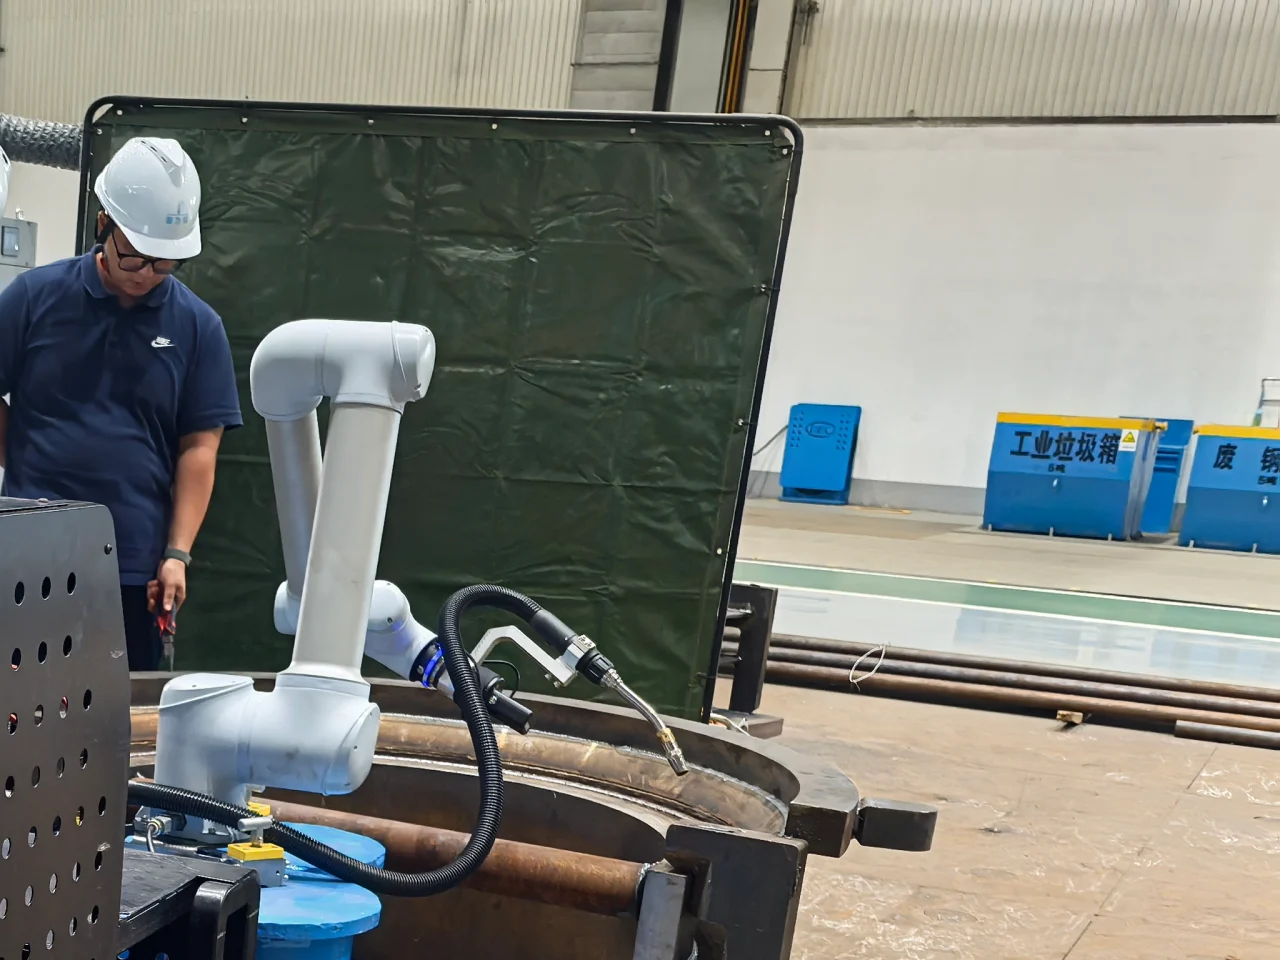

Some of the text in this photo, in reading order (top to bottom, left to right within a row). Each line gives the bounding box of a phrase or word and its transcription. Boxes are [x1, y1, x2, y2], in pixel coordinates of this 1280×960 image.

[1010, 430, 1120, 464] 工业垃圾箱
[1213, 443, 1238, 470] 废
